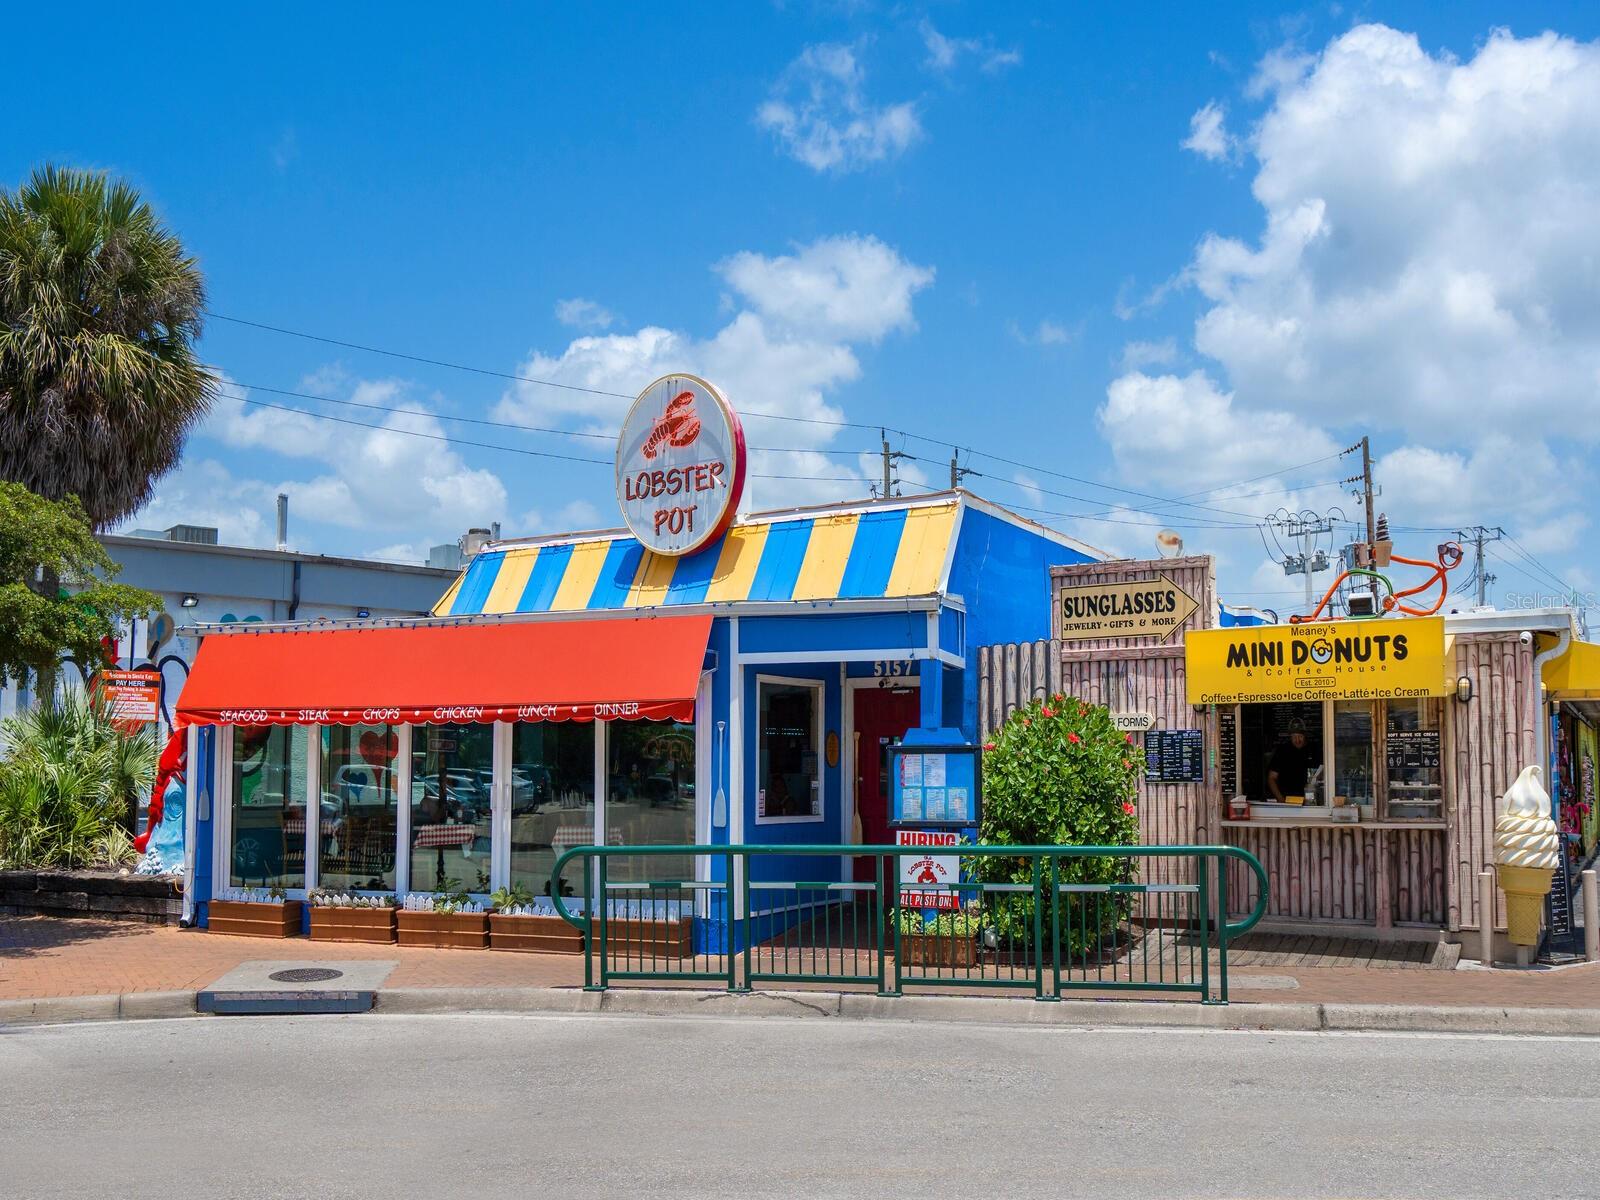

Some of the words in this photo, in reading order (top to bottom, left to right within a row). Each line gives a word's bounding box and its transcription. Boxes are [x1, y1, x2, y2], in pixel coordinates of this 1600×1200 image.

[625, 462, 726, 501] LOBSTER
[654, 505, 697, 536] POT
[1064, 590, 1175, 618] SUNGLASSES
[1064, 621, 1102, 631] JEWELRY
[1109, 619, 1134, 629] GIFTS
[1139, 618, 1147, 627] &
[1151, 617, 1176, 627] MORE
[1291, 625, 1336, 636] Meaney's
[1227, 641, 1284, 668] MINI
[1292, 634, 1408, 665] DONUTS
[874, 660, 912, 676] 5157
[1246, 669, 1253, 677] &
[1266, 667, 1322, 676] Coffee
[1336, 665, 1386, 673] House
[1300, 679, 1311, 687] Est.
[1201, 693, 1232, 703] Coffee
[1238, 692, 1282, 703] Espresso
[1288, 691, 1303, 701] Ice
[1304, 689, 1338, 700] Coffee
[1343, 688, 1370, 699] Latté
[1375, 688, 1391, 698] Ice
[1394, 687, 1430, 697] Cream
[220, 709, 268, 722] SEAFOOD
[298, 708, 330, 721] STEAK
[362, 708, 400, 720] CHOPS
[433, 706, 484, 719] CHICKEN
[517, 704, 558, 717] LUNCH
[594, 702, 639, 716] DINNER
[1117, 716, 1149, 727] FORMS
[900, 832, 956, 846] HIRING
[908, 860, 934, 875] LOBSTER
[935, 863, 947, 876] POT
